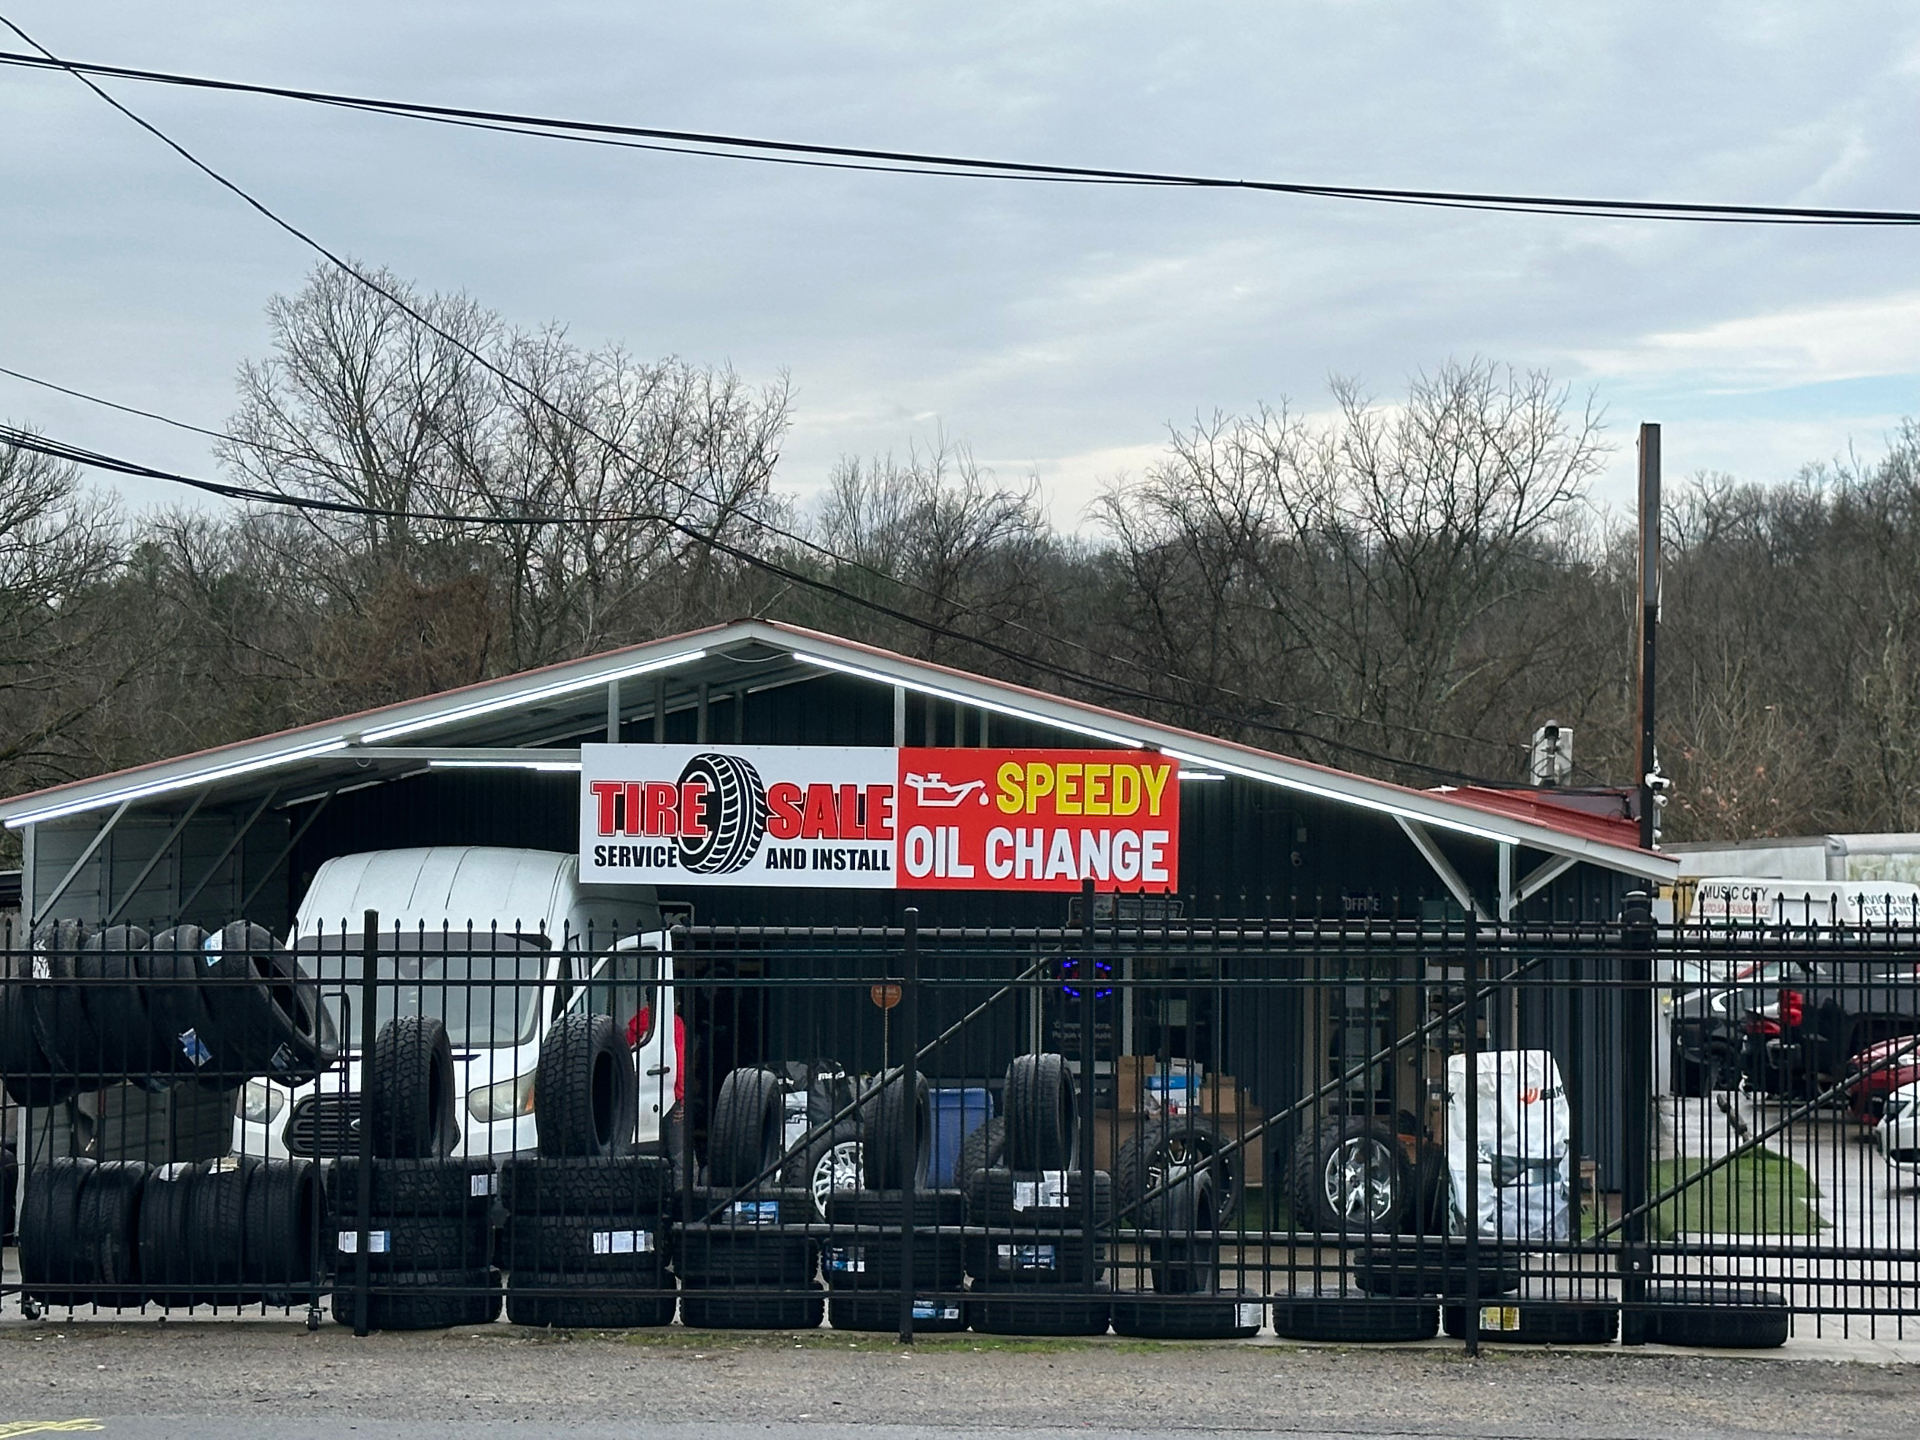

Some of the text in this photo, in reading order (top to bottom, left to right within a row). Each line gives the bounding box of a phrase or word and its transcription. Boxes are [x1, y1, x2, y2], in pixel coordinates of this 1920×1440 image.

[590, 780, 894, 840] TIRE SALE
[996, 762, 1171, 816] SPEEDY
[594, 845, 891, 872] SERVICE AND INSTALL
[905, 825, 1170, 882] OIL CHANGE
[1864, 906, 1880, 916] DE
